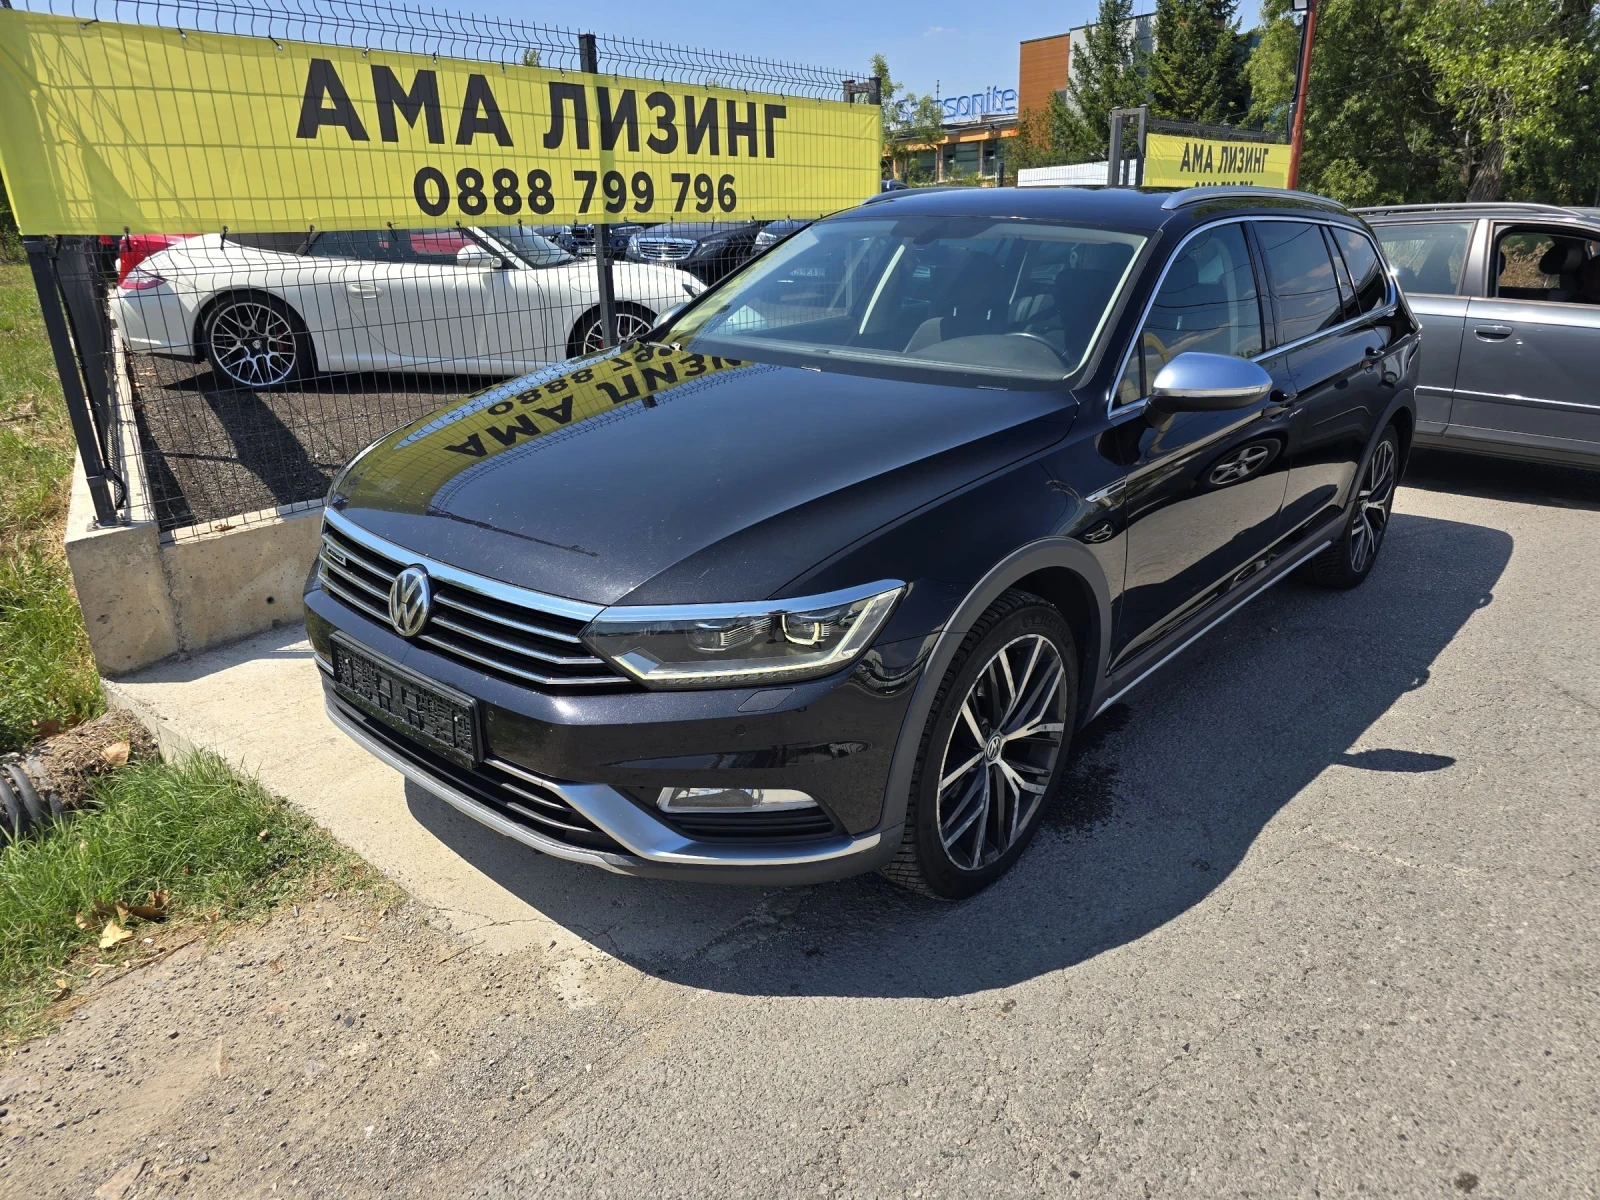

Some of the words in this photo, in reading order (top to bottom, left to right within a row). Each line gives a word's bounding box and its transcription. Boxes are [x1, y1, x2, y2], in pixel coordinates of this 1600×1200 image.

[297, 58, 515, 148] АМА
[544, 82, 787, 159] ЛИЗИНГ
[1179, 142, 1214, 173] АМА
[1217, 146, 1269, 174] ЛИЗИНГ
[414, 166, 555, 216] 0888
[574, 170, 655, 213] 799
[672, 173, 737, 213] 796
